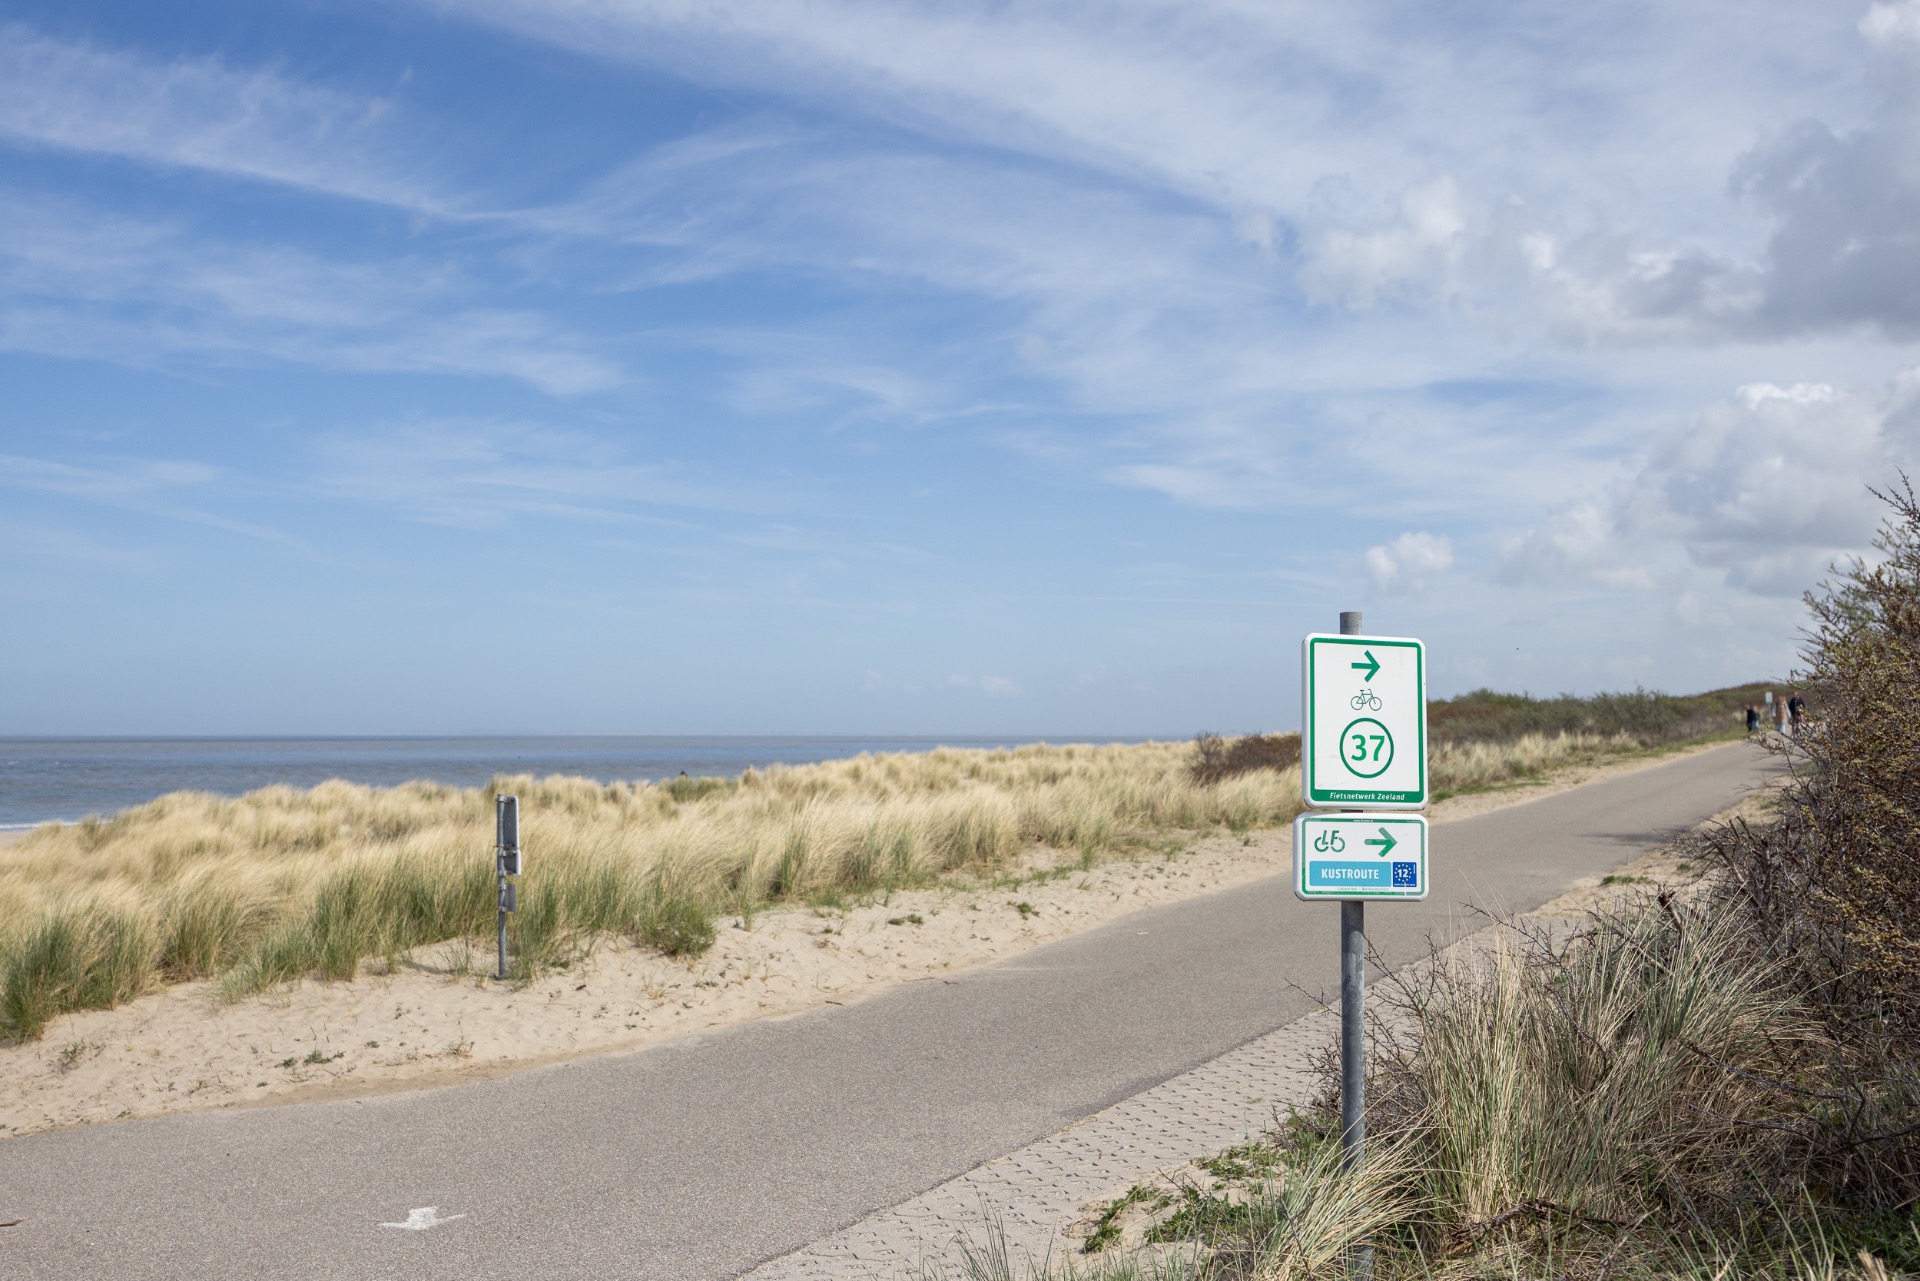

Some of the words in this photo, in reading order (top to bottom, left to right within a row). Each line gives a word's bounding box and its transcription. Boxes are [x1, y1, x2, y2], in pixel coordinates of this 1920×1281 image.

[1351, 734, 1385, 762] 37
[1329, 792, 1376, 800] Fietsnetwerk
[1377, 793, 1405, 801] Zeeland
[1321, 868, 1379, 879] KUSTROUTE
[1397, 868, 1409, 878] 12
